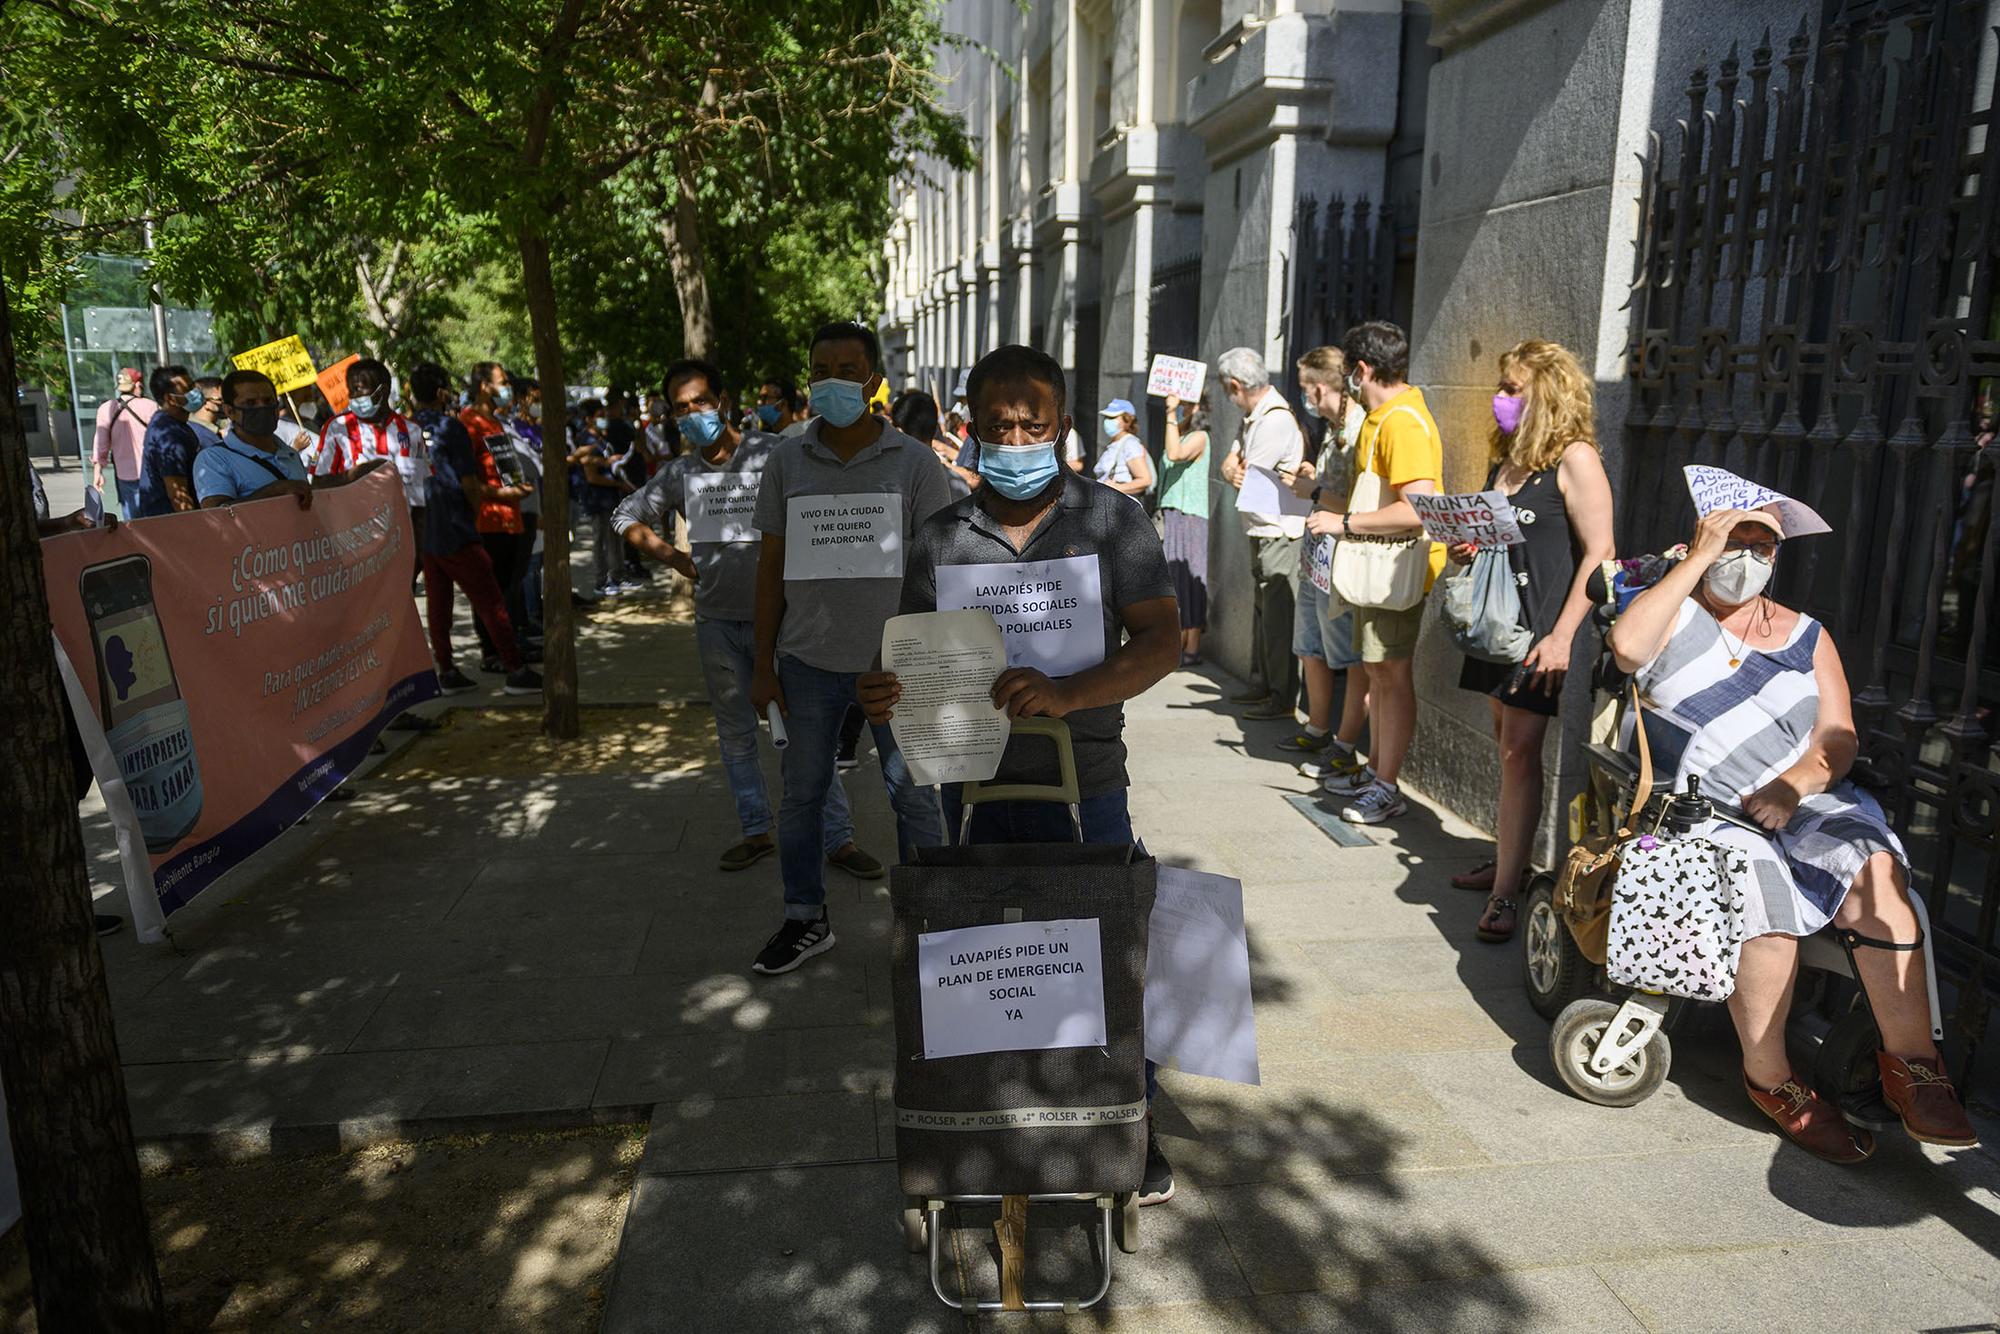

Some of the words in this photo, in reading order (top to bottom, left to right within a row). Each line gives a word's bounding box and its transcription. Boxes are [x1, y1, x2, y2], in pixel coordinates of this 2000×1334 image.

[697, 484, 716, 494] VIVO
[716, 484, 728, 493] EN
[728, 483, 738, 492] LA
[739, 482, 761, 492] CIUDA
[709, 497, 714, 505] Y
[715, 496, 728, 504] ME
[728, 495, 757, 505] QUIERO
[1415, 494, 1493, 511] AYUNTA
[1701, 487, 1748, 513] gente
[708, 507, 755, 516] EMPADRONA
[801, 508, 822, 520] VIVO
[823, 508, 836, 518] EN
[837, 507, 849, 517] LA
[850, 505, 885, 516] CIUDAD
[1420, 509, 1495, 525] MIENTO
[813, 523, 820, 533] Y
[821, 523, 836, 532] ME
[837, 520, 872, 531] QUIERO
[1428, 523, 1462, 537] HAZ
[811, 534, 875, 546] EMPADRONAR
[1387, 535, 1418, 550] yet?
[976, 581, 1033, 597] LAVAPIÉS
[1036, 580, 1063, 593] PIDE
[204, 596, 224, 636] si
[282, 580, 306, 611] me
[309, 565, 349, 602] cuida
[1022, 597, 1078, 614] SOCIALES
[1006, 618, 1073, 634] POLICIALES
[263, 669, 291, 697] Para
[294, 659, 314, 691] que
[128, 785, 160, 812] PARA
[161, 758, 195, 807] SANAR
[950, 945, 1012, 966] LAVAPIÉS
[1015, 943, 1045, 957] PIDE
[1048, 942, 1069, 954] UN
[938, 972, 972, 988] PLAN
[976, 970, 993, 983] DE
[997, 961, 1084, 980] EMERGENCIA
[989, 985, 1036, 1001] SOCIAL
[1004, 1008, 1023, 1021] YA
[917, 1115, 957, 1127] ROLSER
[978, 1113, 1018, 1126] ROLSER
[1038, 1110, 1079, 1122] ROLSER
[1099, 1107, 1139, 1121] ROLSER
